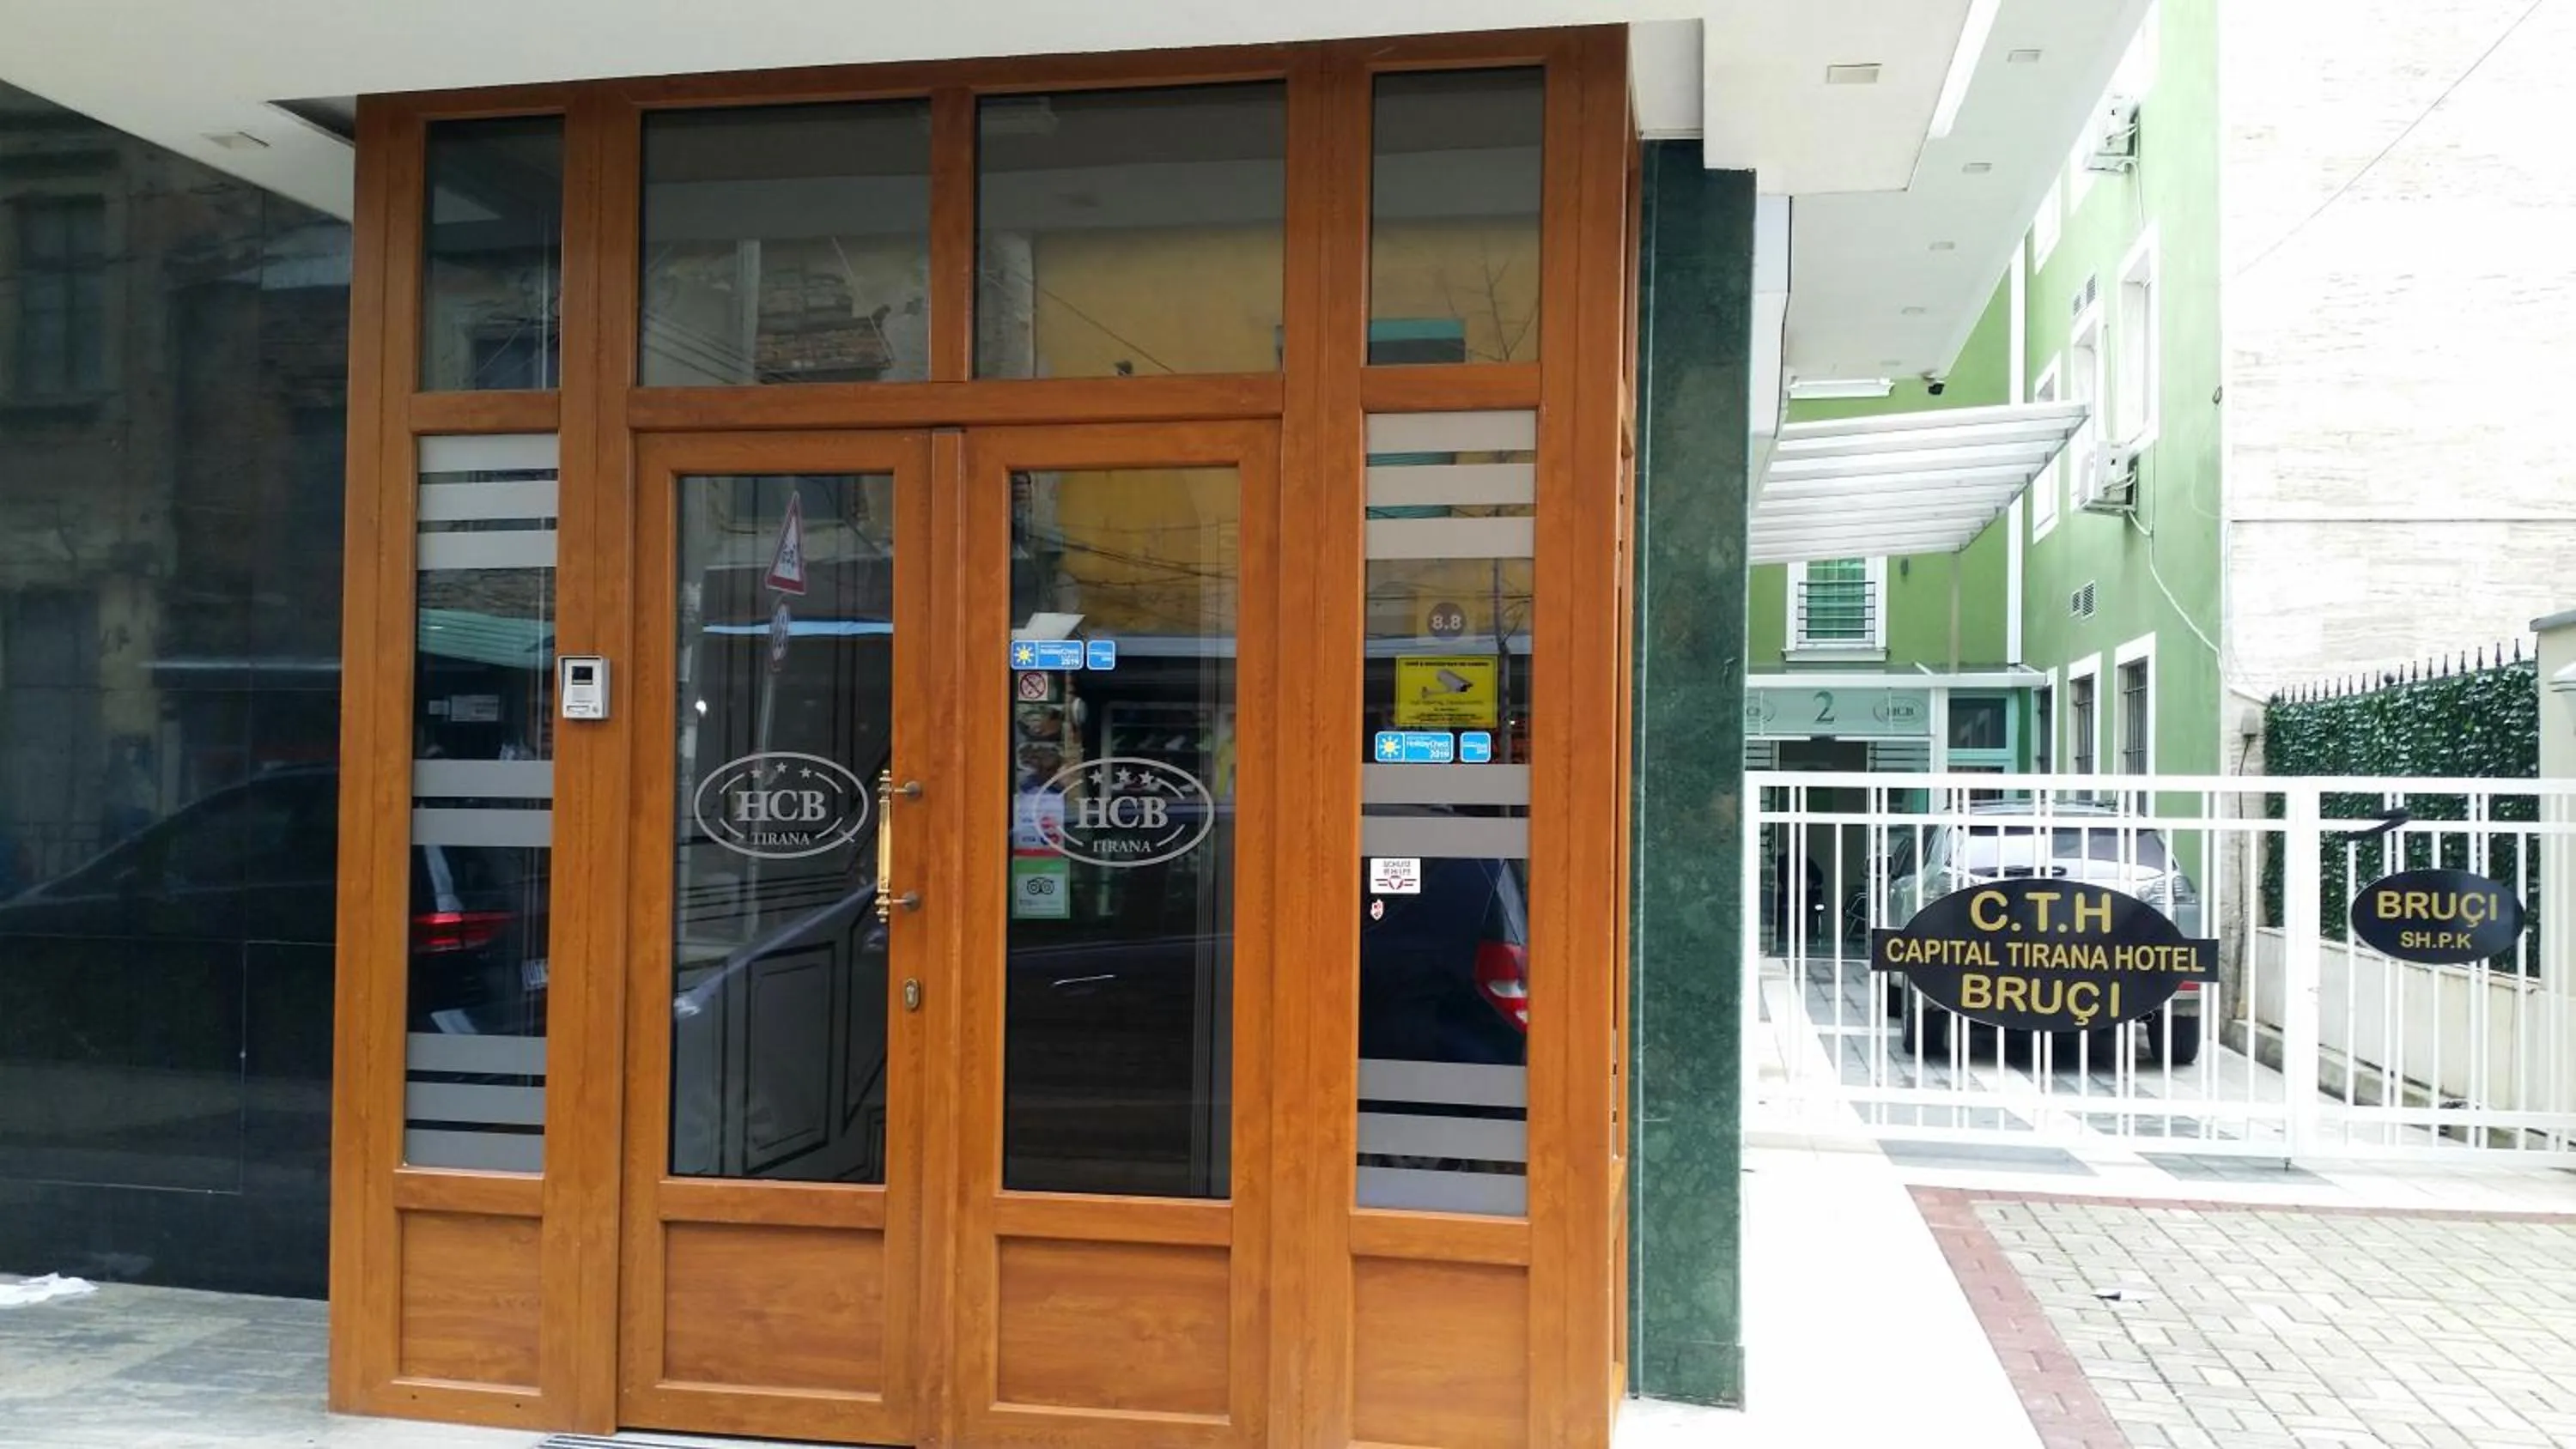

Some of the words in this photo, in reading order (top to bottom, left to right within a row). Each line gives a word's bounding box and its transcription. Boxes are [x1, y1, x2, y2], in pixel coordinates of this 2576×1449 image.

[1431, 614, 1462, 631] 8.8
[1813, 690, 1836, 725] 2
[735, 789, 827, 822] HCB
[1074, 796, 1169, 829] HCB
[751, 832, 811, 846] TIRANA
[1092, 839, 1151, 852] TIRANA
[1970, 889, 2112, 934] C.T.H
[2376, 890, 2499, 928] BRUÇI
[1886, 937, 2000, 967] CAPITAL
[2006, 941, 2109, 971] TIRANA
[2114, 943, 2206, 973] HOTEL
[2400, 931, 2473, 949] SH.P.K
[1960, 973, 2121, 1026] BRUÇI
